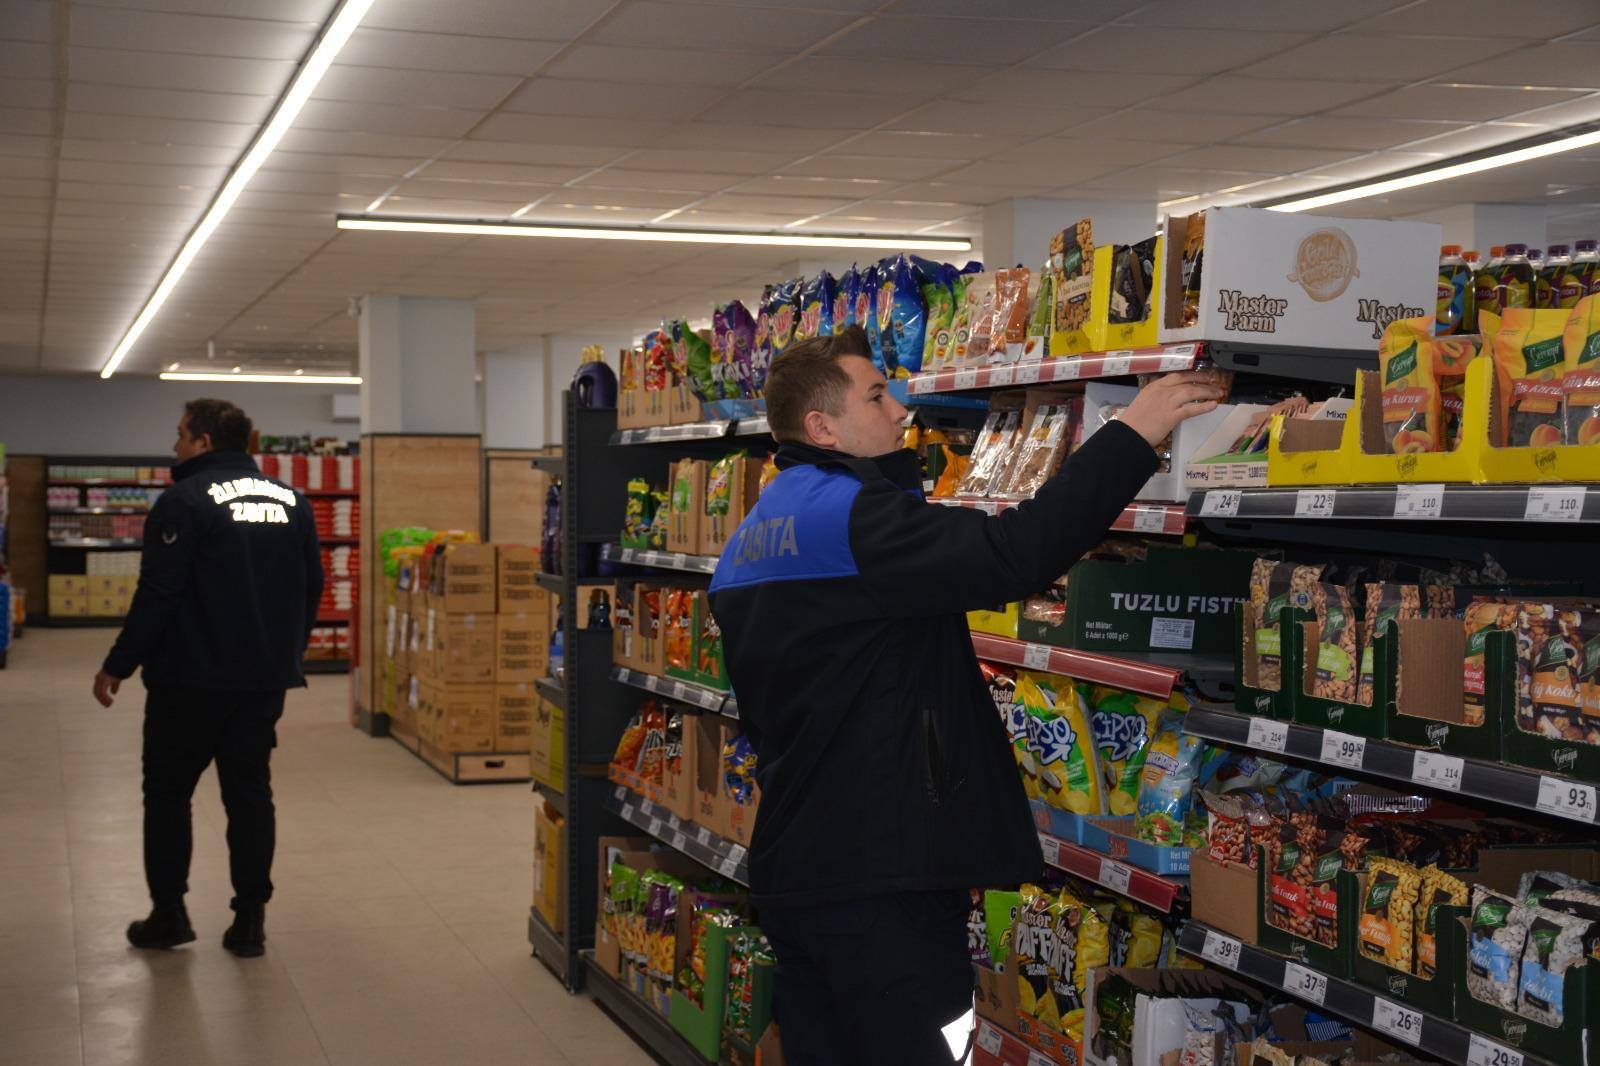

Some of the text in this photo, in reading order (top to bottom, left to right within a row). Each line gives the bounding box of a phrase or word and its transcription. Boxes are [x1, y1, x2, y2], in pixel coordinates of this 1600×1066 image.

[1218, 289, 1288, 317] Master
[1357, 299, 1425, 323] Master
[1225, 312, 1276, 333] Farm
[734, 515, 799, 566] ZABITA
[1110, 592, 1250, 614] TUZLU FIST
[1568, 788, 1587, 808] 93
